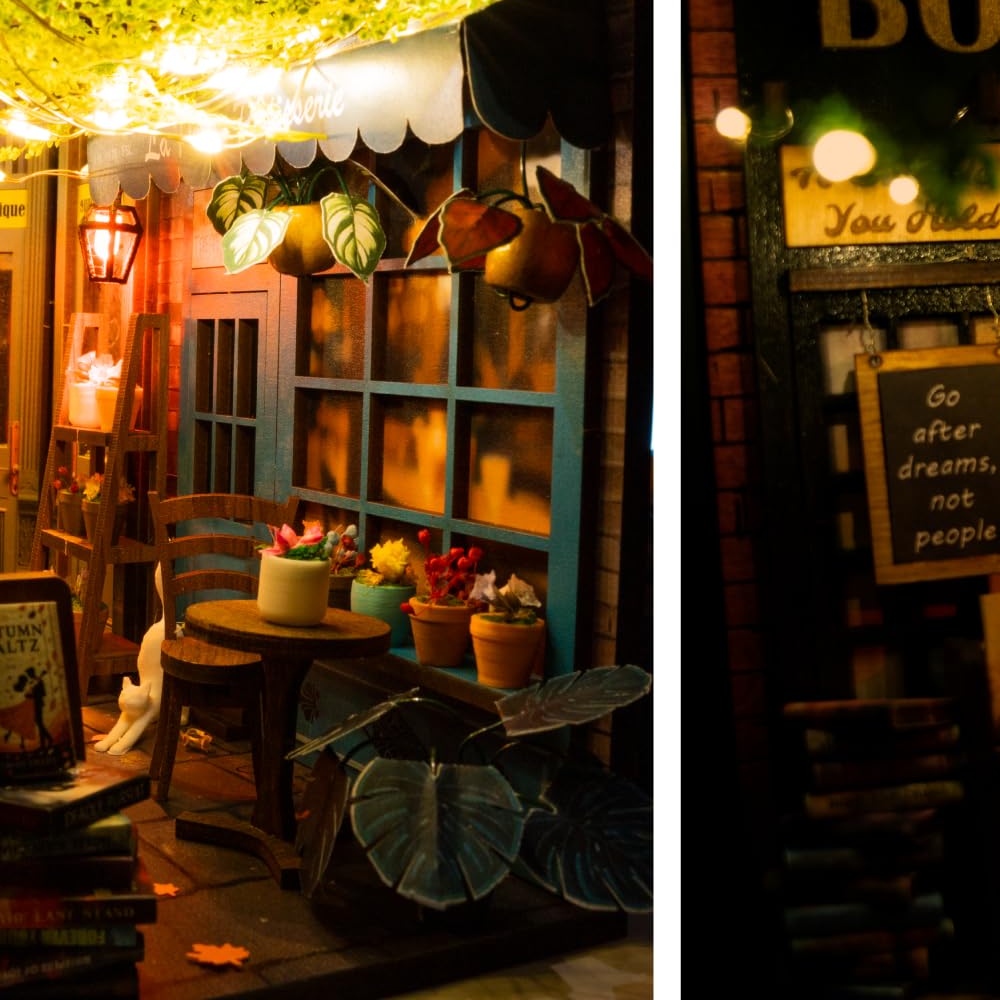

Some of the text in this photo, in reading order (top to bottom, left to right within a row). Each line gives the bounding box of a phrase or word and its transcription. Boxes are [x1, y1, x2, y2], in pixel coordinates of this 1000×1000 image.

[824, 202, 895, 239] You
[926, 383, 961, 408] Go
[912, 418, 982, 444] after
[897, 453, 997, 480] dreams,
[929, 488, 976, 511] not
[913, 518, 998, 554] people
